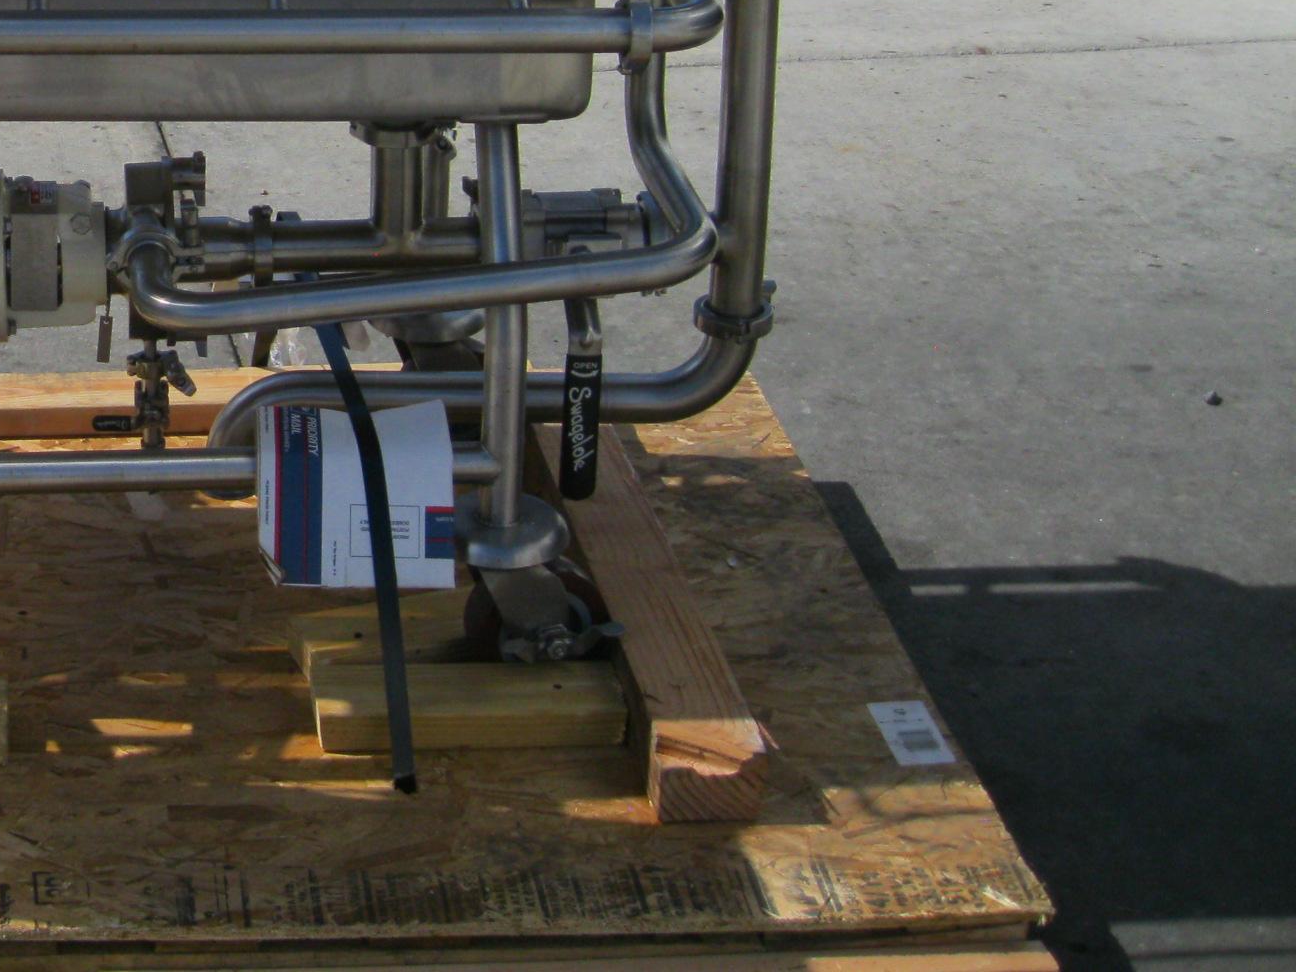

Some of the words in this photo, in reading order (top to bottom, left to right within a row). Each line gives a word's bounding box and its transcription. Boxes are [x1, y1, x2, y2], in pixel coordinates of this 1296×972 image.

[573, 361, 598, 370] OPEN
[290, 413, 302, 435] MAIL
[306, 416, 320, 458] PRIORITY
[567, 386, 594, 472] Swagelok
